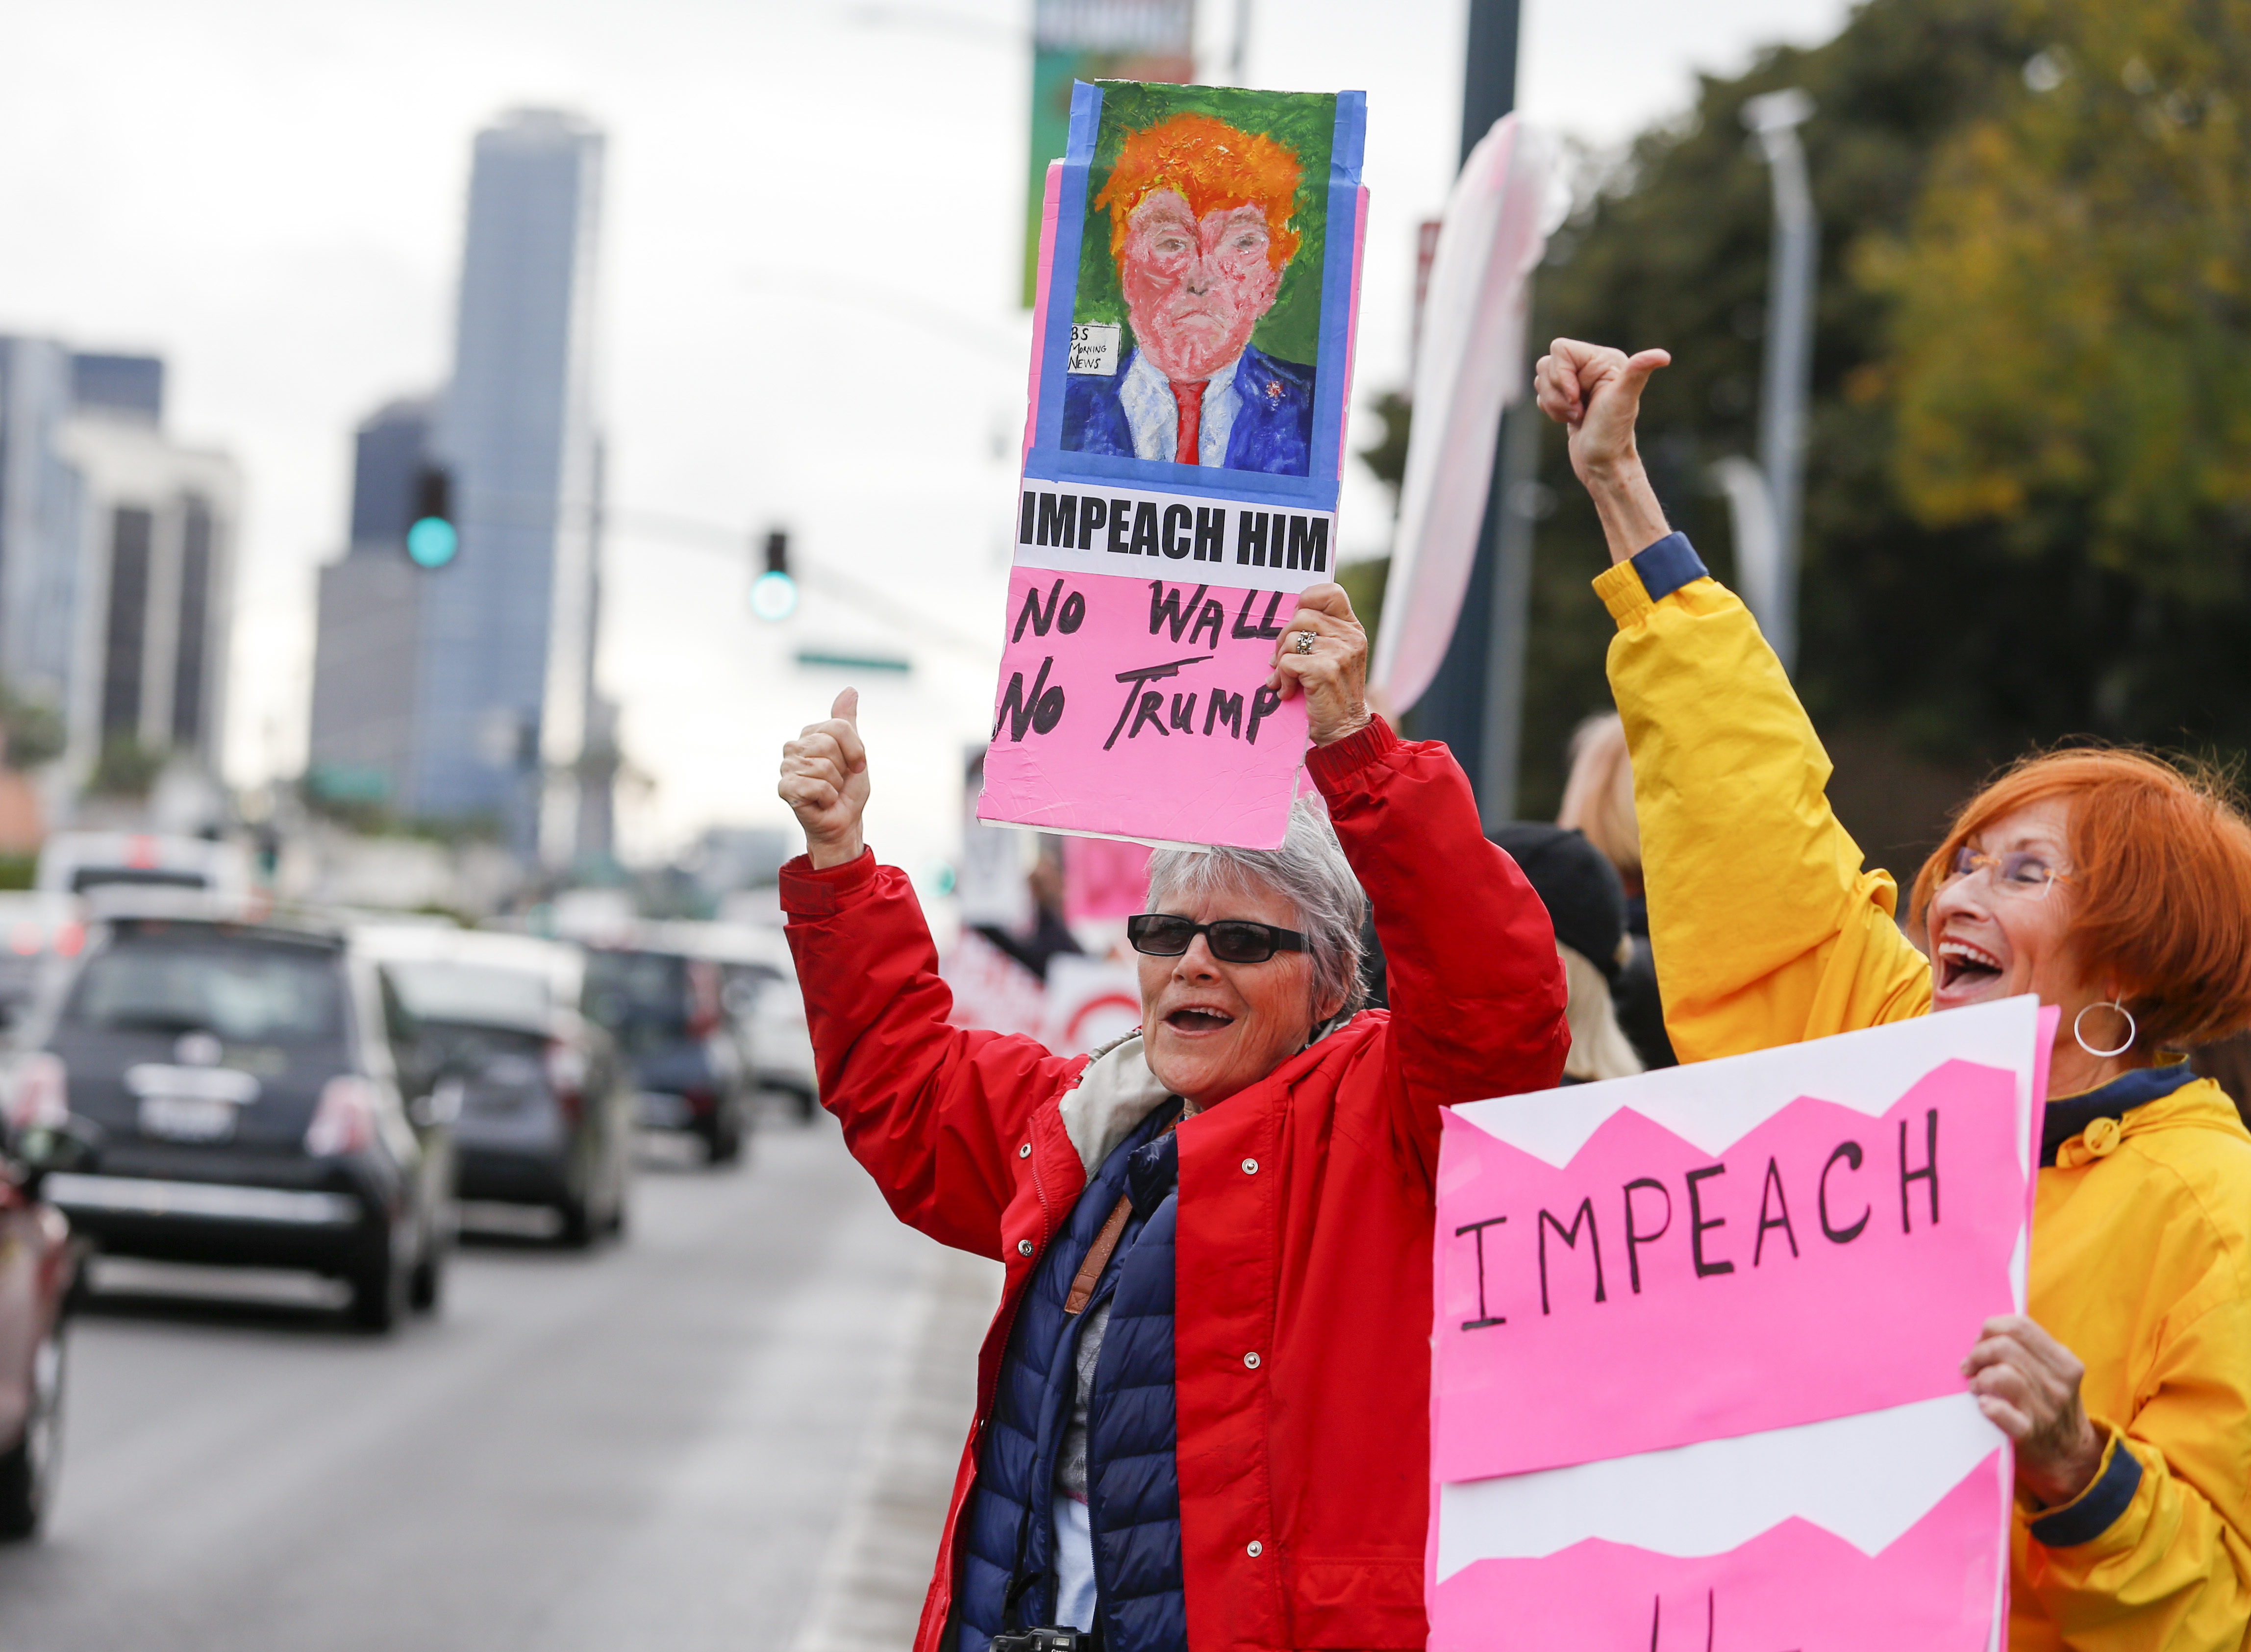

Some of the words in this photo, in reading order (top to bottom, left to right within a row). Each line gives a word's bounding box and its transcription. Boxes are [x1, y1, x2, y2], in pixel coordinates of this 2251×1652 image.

[1068, 354, 1101, 371] NEWS
[1071, 326, 1089, 341] BS
[1020, 491, 1226, 562] IMPEACH
[1236, 511, 1329, 572] HIM
[1012, 579, 1085, 643] NO
[1148, 579, 1283, 650] WALL
[992, 656, 1065, 742] NO
[1103, 655, 1280, 751] TRUMP
[1455, 1108, 1938, 1331] IMPEACH
